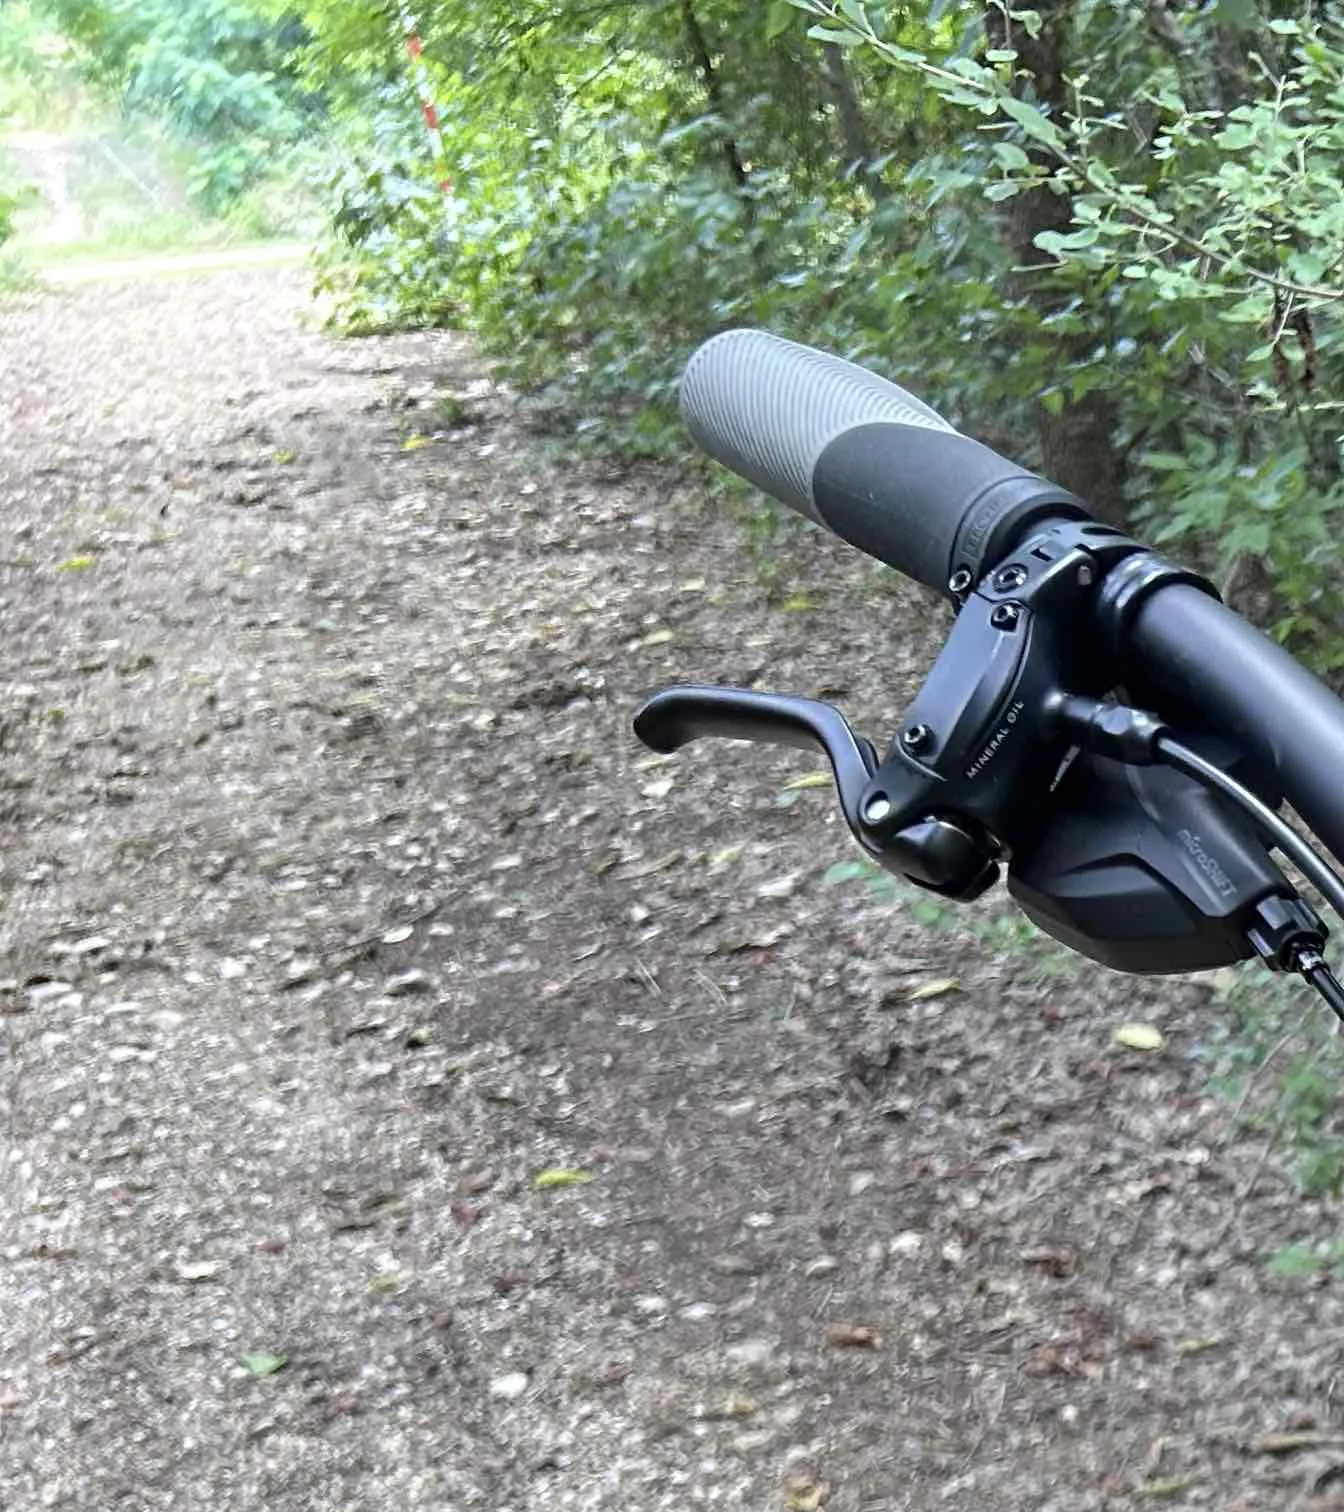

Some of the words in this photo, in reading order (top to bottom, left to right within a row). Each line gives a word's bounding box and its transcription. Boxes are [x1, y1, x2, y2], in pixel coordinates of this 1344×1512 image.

[966, 727, 1009, 779] MINERAL
[1006, 700, 1025, 724] OIL
[1177, 829, 1237, 897] microSHIFT
